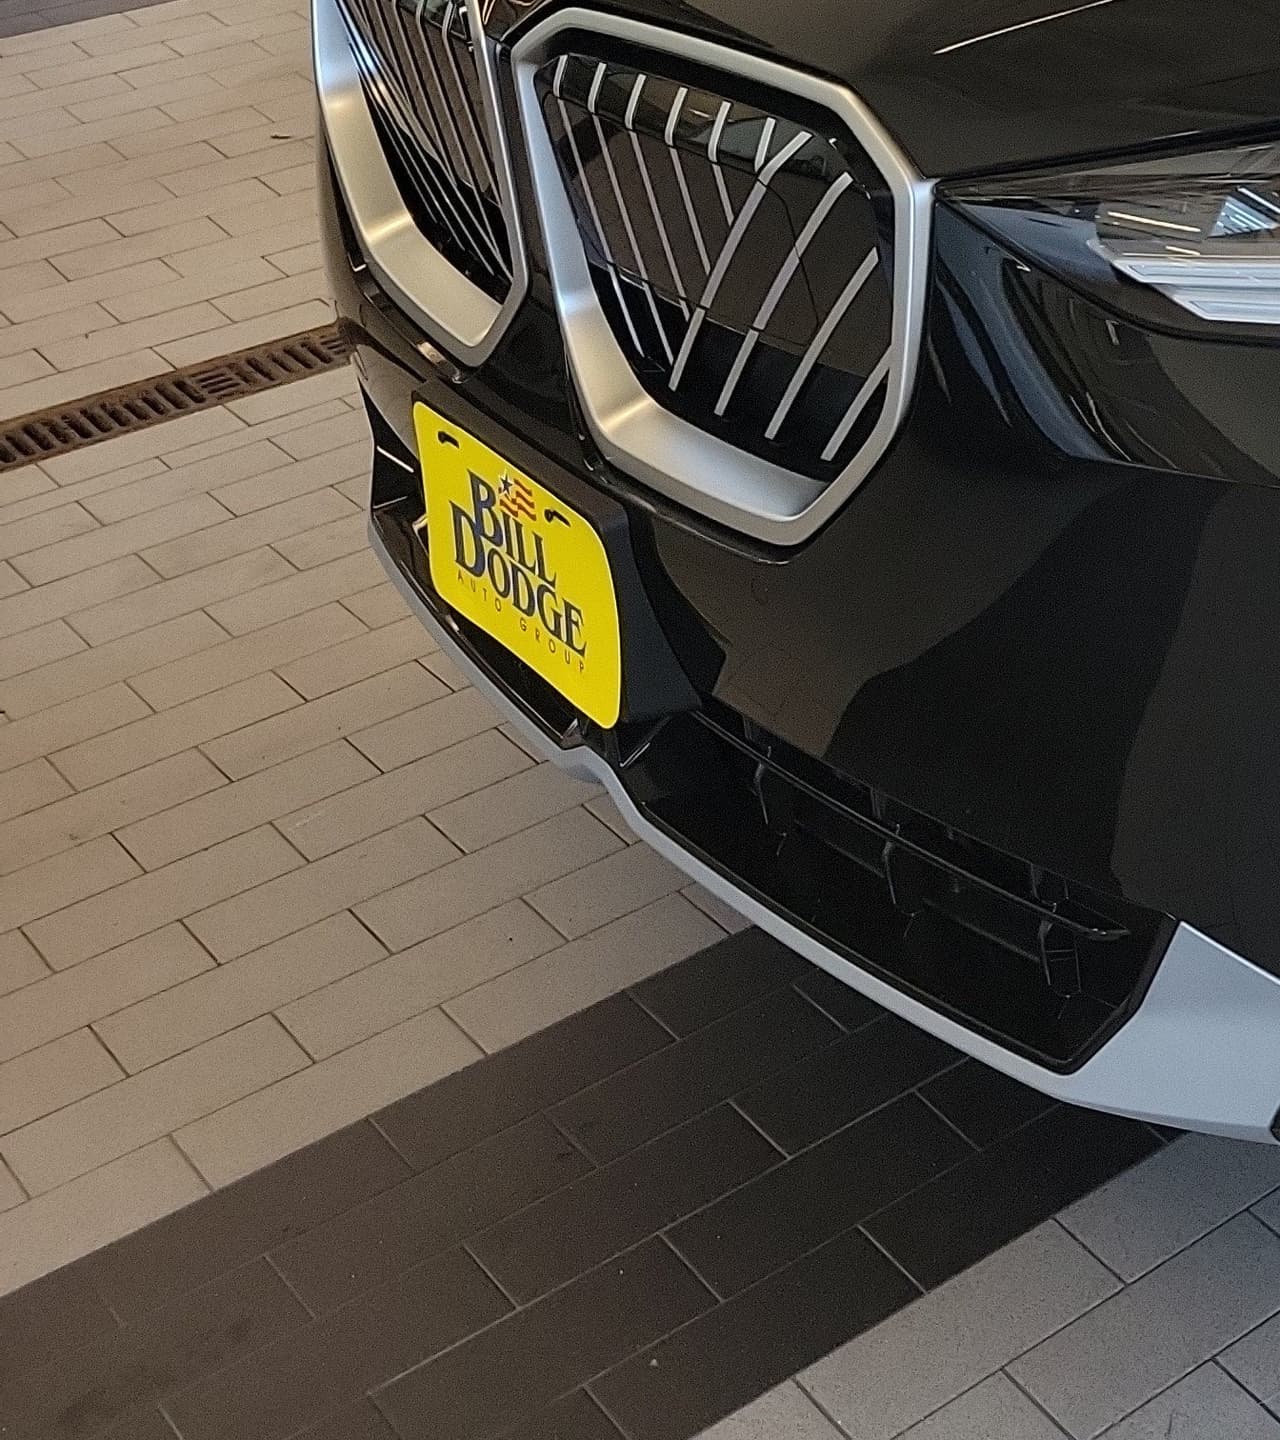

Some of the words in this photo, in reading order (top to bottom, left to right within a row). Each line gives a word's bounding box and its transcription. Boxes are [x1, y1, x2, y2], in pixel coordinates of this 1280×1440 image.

[449, 500, 587, 658] DODGE
[467, 468, 557, 590] BILL
[457, 572, 502, 612] AUTO
[519, 616, 586, 673] GROUP
